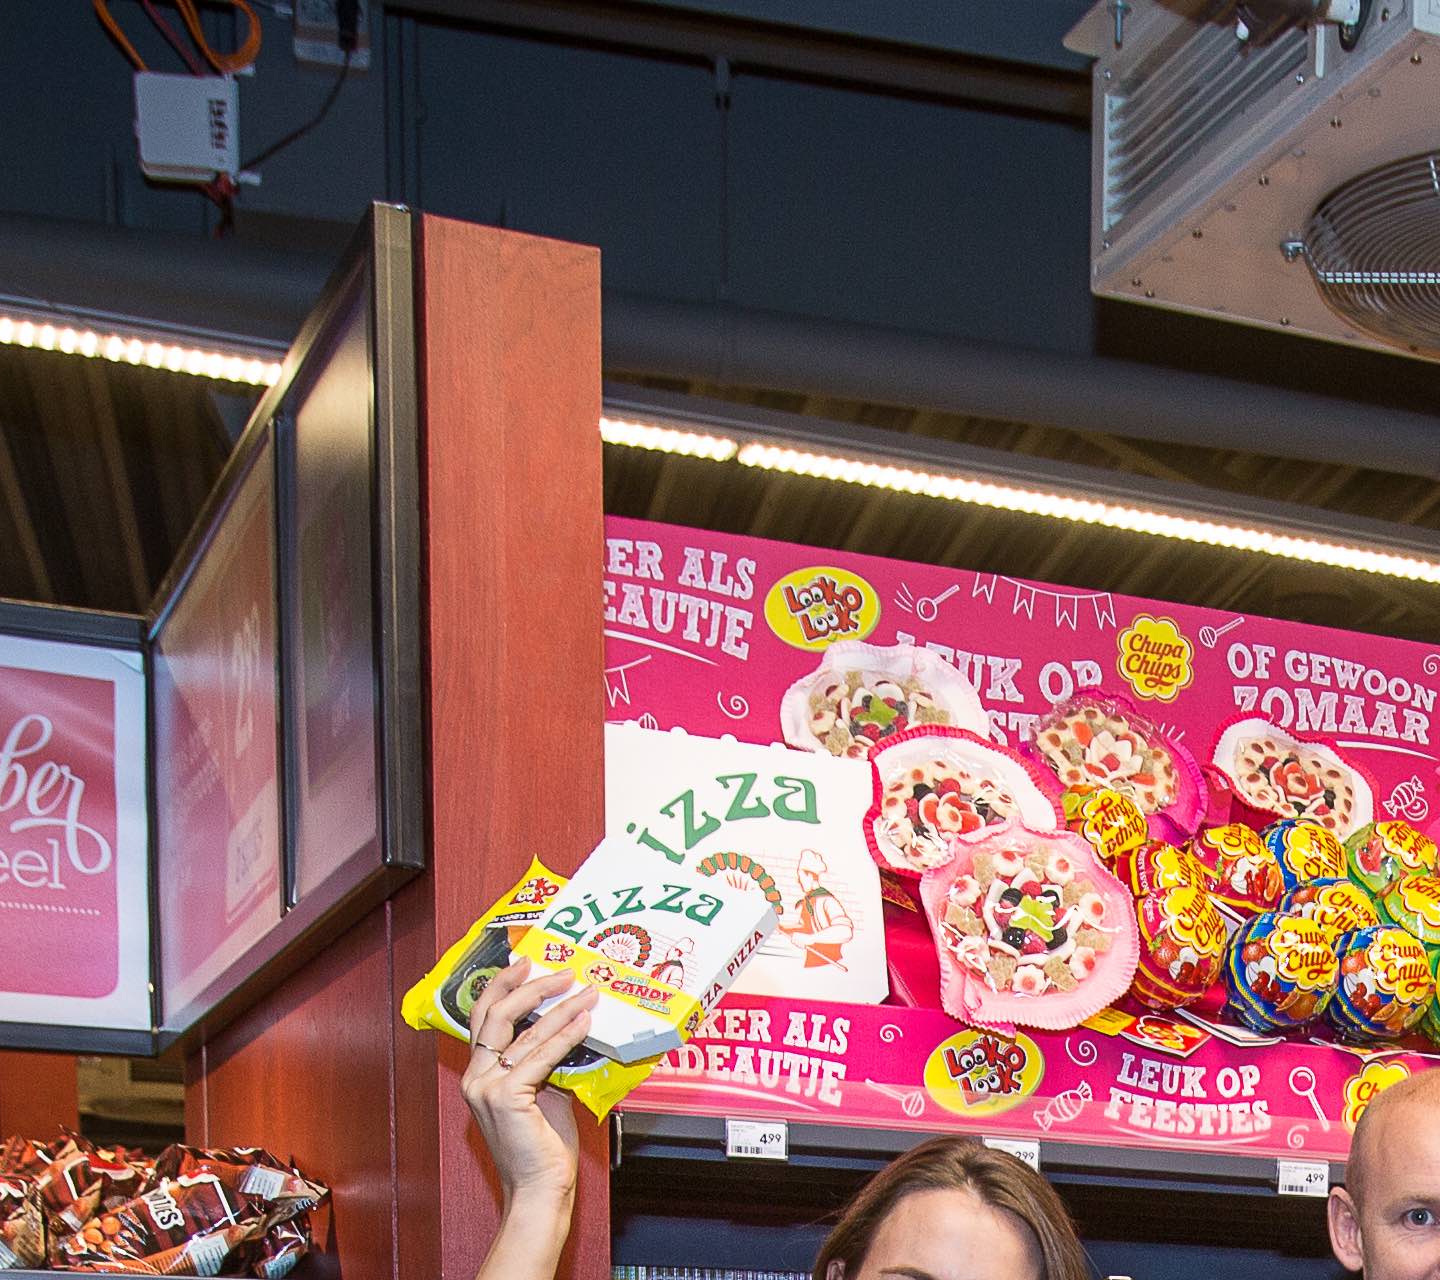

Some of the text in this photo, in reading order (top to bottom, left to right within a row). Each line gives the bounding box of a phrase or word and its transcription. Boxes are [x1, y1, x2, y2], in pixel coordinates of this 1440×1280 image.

[677, 547, 758, 600] ALS
[604, 582, 753, 661] EAUTJE
[1125, 652, 1182, 689] Chups
[1127, 633, 1185, 662] Chupa
[1038, 658, 1105, 704] OP
[1226, 641, 1439, 714] OF GEWOON
[1232, 684, 1430, 746] ZOMAAR
[626, 770, 822, 866] izza
[725, 930, 764, 977] PIZZA
[610, 979, 673, 1003] CANDY
[781, 1014, 852, 1057] ALS
[652, 1044, 849, 1108] ADEAUTJE
[1116, 1051, 1264, 1100] LEUK OP
[1104, 1086, 1272, 1136] FEESTJES
